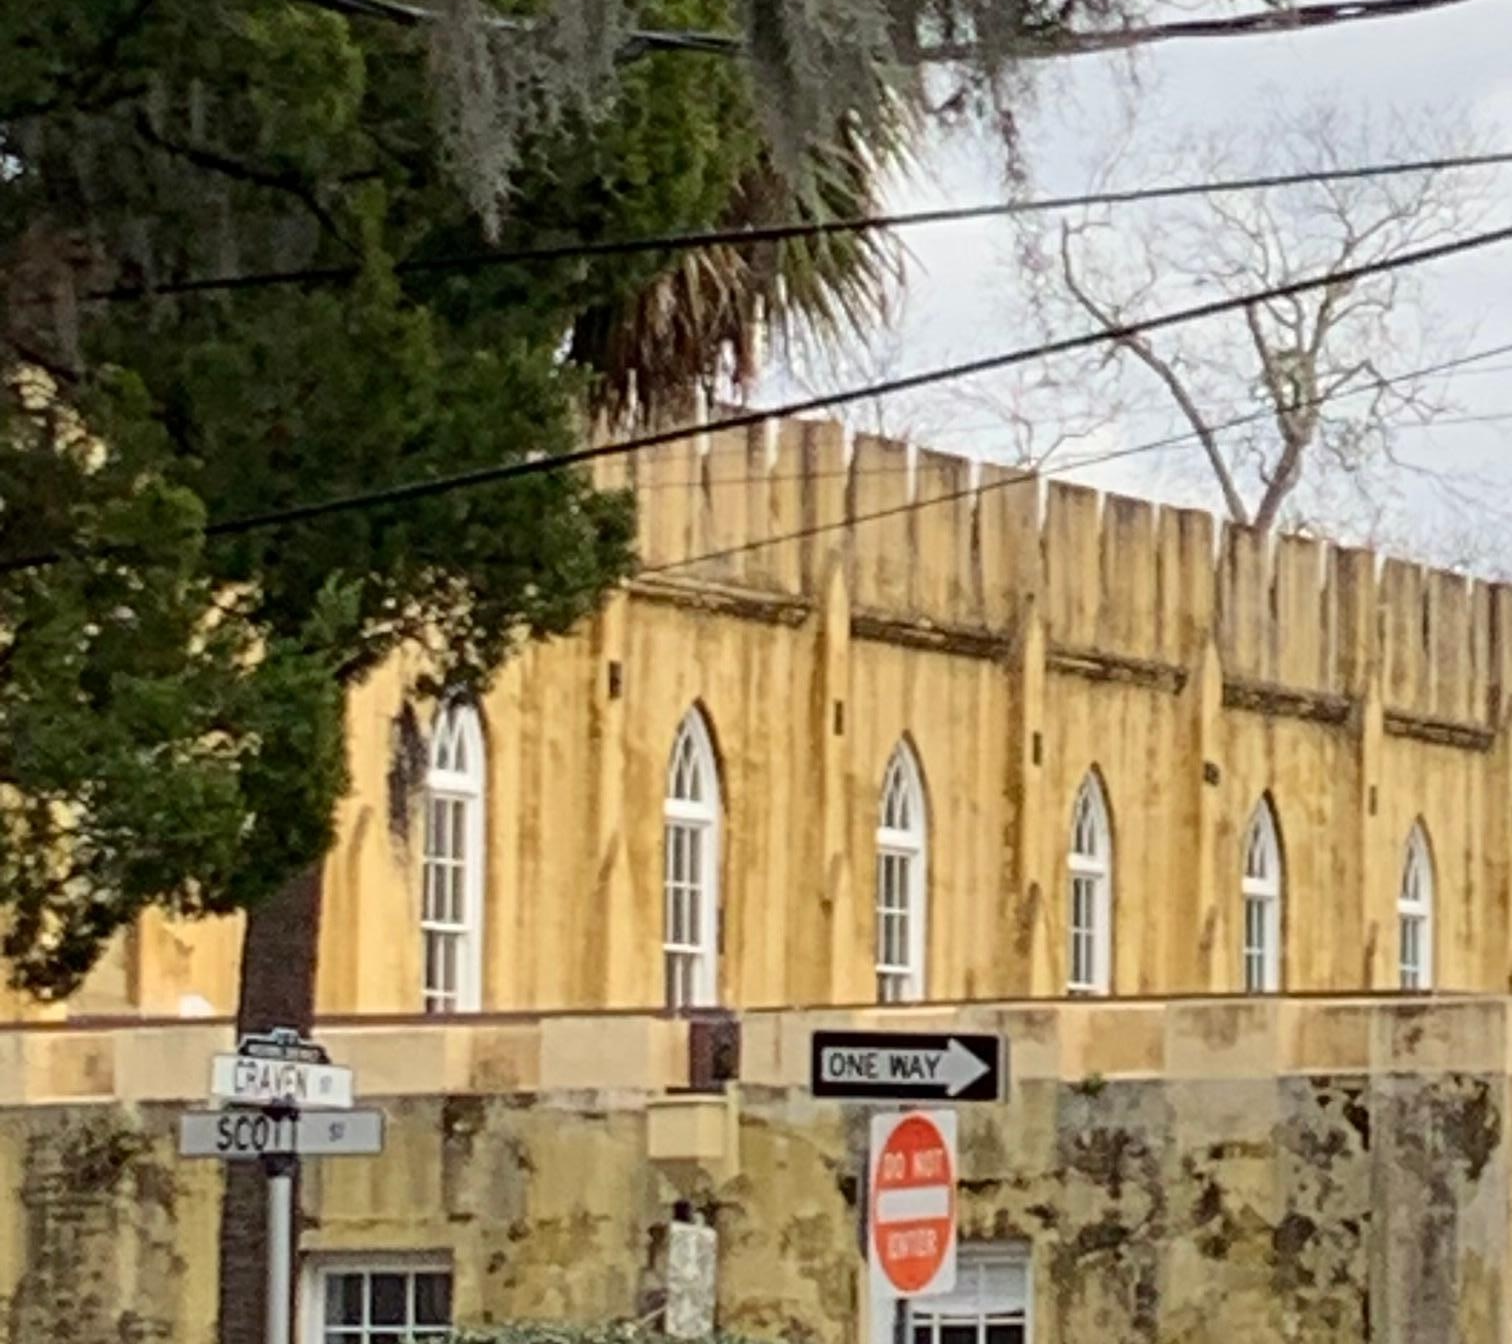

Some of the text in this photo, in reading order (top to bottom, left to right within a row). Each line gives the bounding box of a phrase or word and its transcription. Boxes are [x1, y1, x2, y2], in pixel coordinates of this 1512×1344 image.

[234, 1060, 308, 1097] CRAVEN
[829, 1053, 942, 1080] ONE WAY
[884, 1148, 944, 1180] DO NOT
[888, 1229, 937, 1260] ENTER
